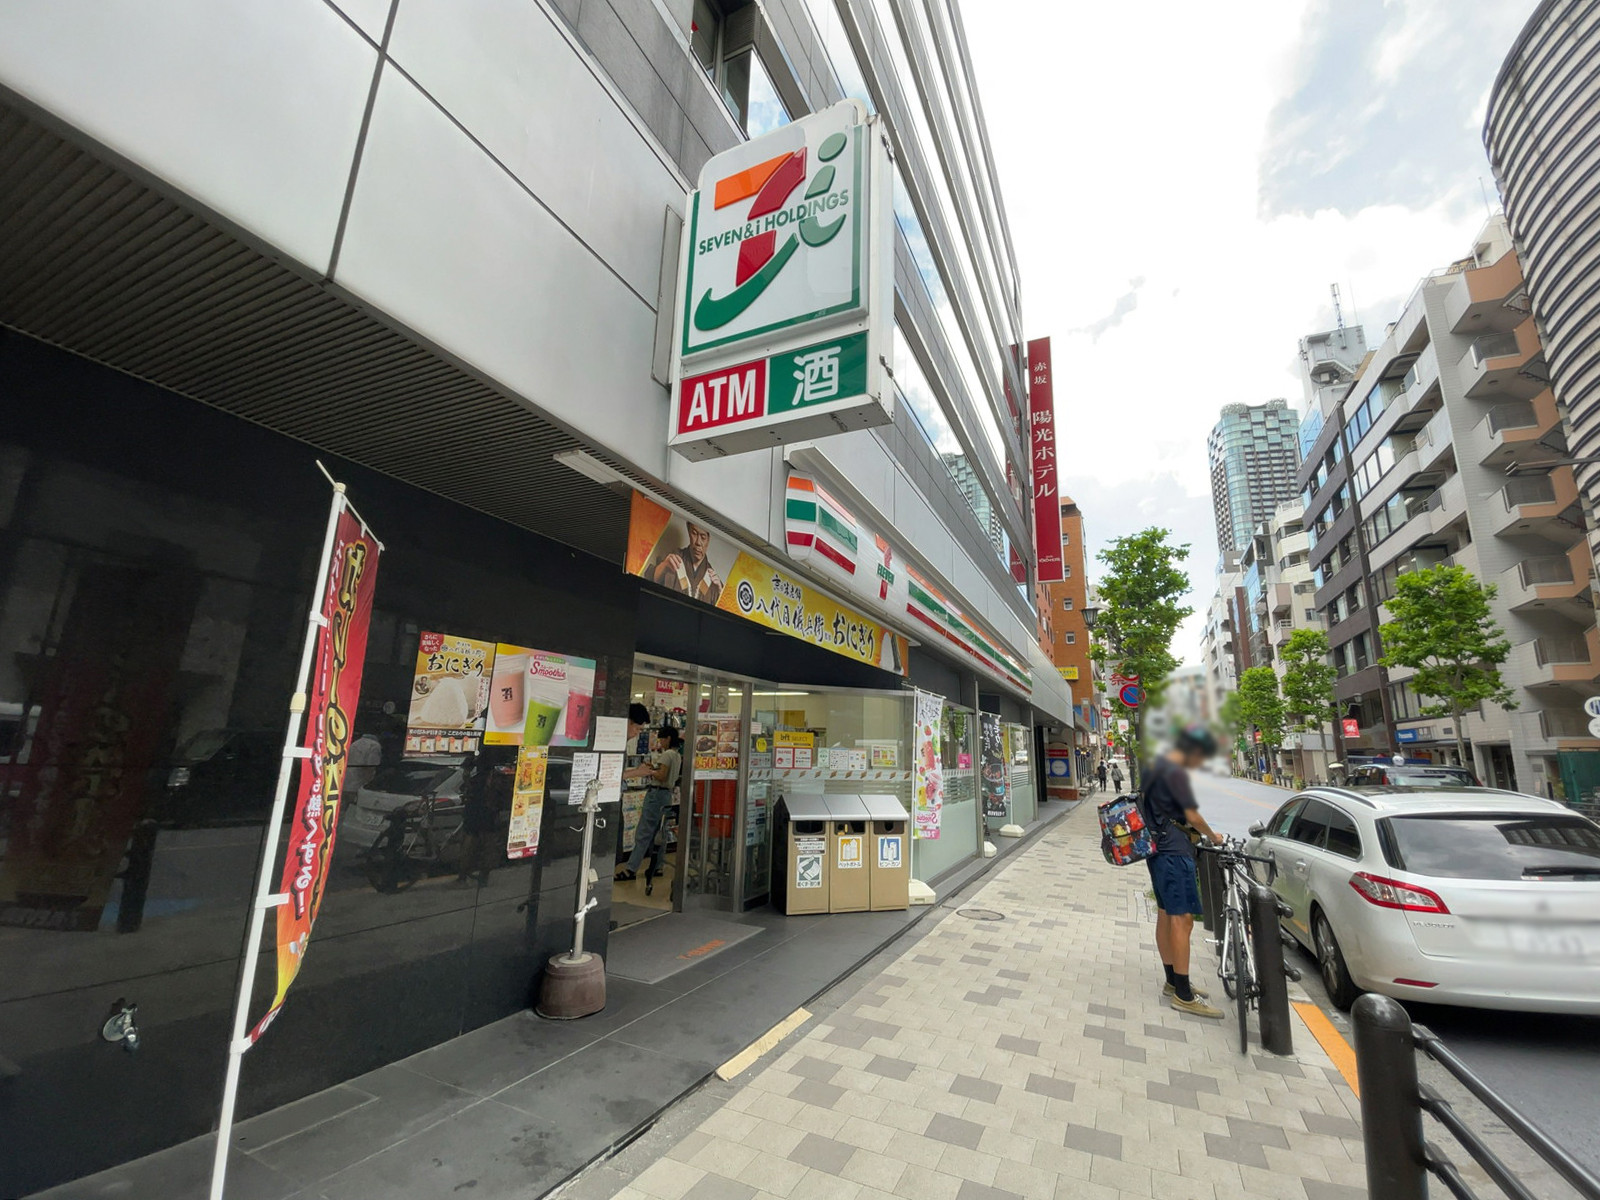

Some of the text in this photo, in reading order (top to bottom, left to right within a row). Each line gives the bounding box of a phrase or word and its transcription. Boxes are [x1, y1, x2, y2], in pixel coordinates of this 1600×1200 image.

[765, 189, 850, 232] HOLDINGS
[686, 369, 757, 427] ATM
[791, 346, 842, 406] 酒
[1032, 361, 1056, 499] 赤坂 陽光ホテル
[877, 564, 895, 584] ELEVEN
[832, 610, 874, 660] おにぎり
[427, 653, 484, 677] おにぎり
[529, 661, 566, 679] Smoothie
